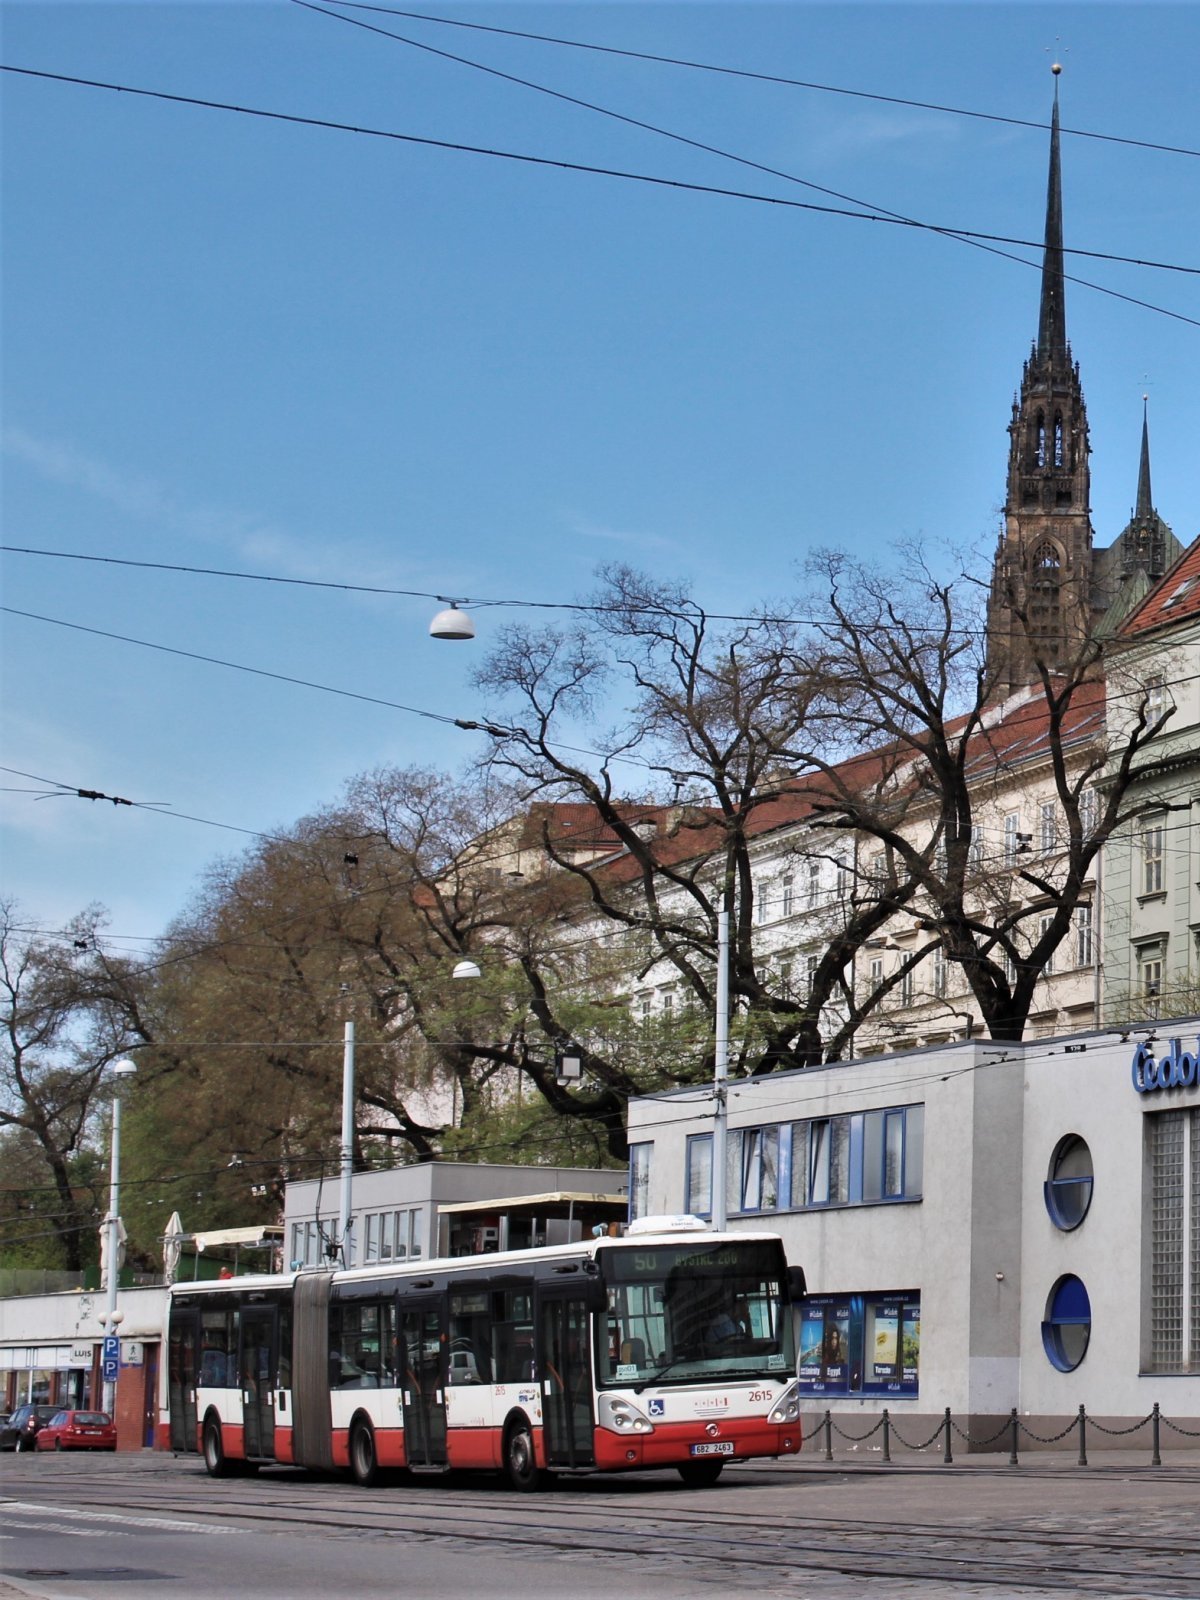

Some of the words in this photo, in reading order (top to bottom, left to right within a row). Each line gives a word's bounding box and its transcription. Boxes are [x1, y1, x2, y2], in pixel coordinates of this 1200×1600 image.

[634, 1253, 657, 1271] 50
[106, 1339, 116, 1353] P
[106, 1361, 116, 1374] P
[827, 1367, 841, 1377] Egypt
[748, 1390, 773, 1402] 2615
[696, 1444, 710, 1453] 6B2
[714, 1443, 731, 1452] 2463
